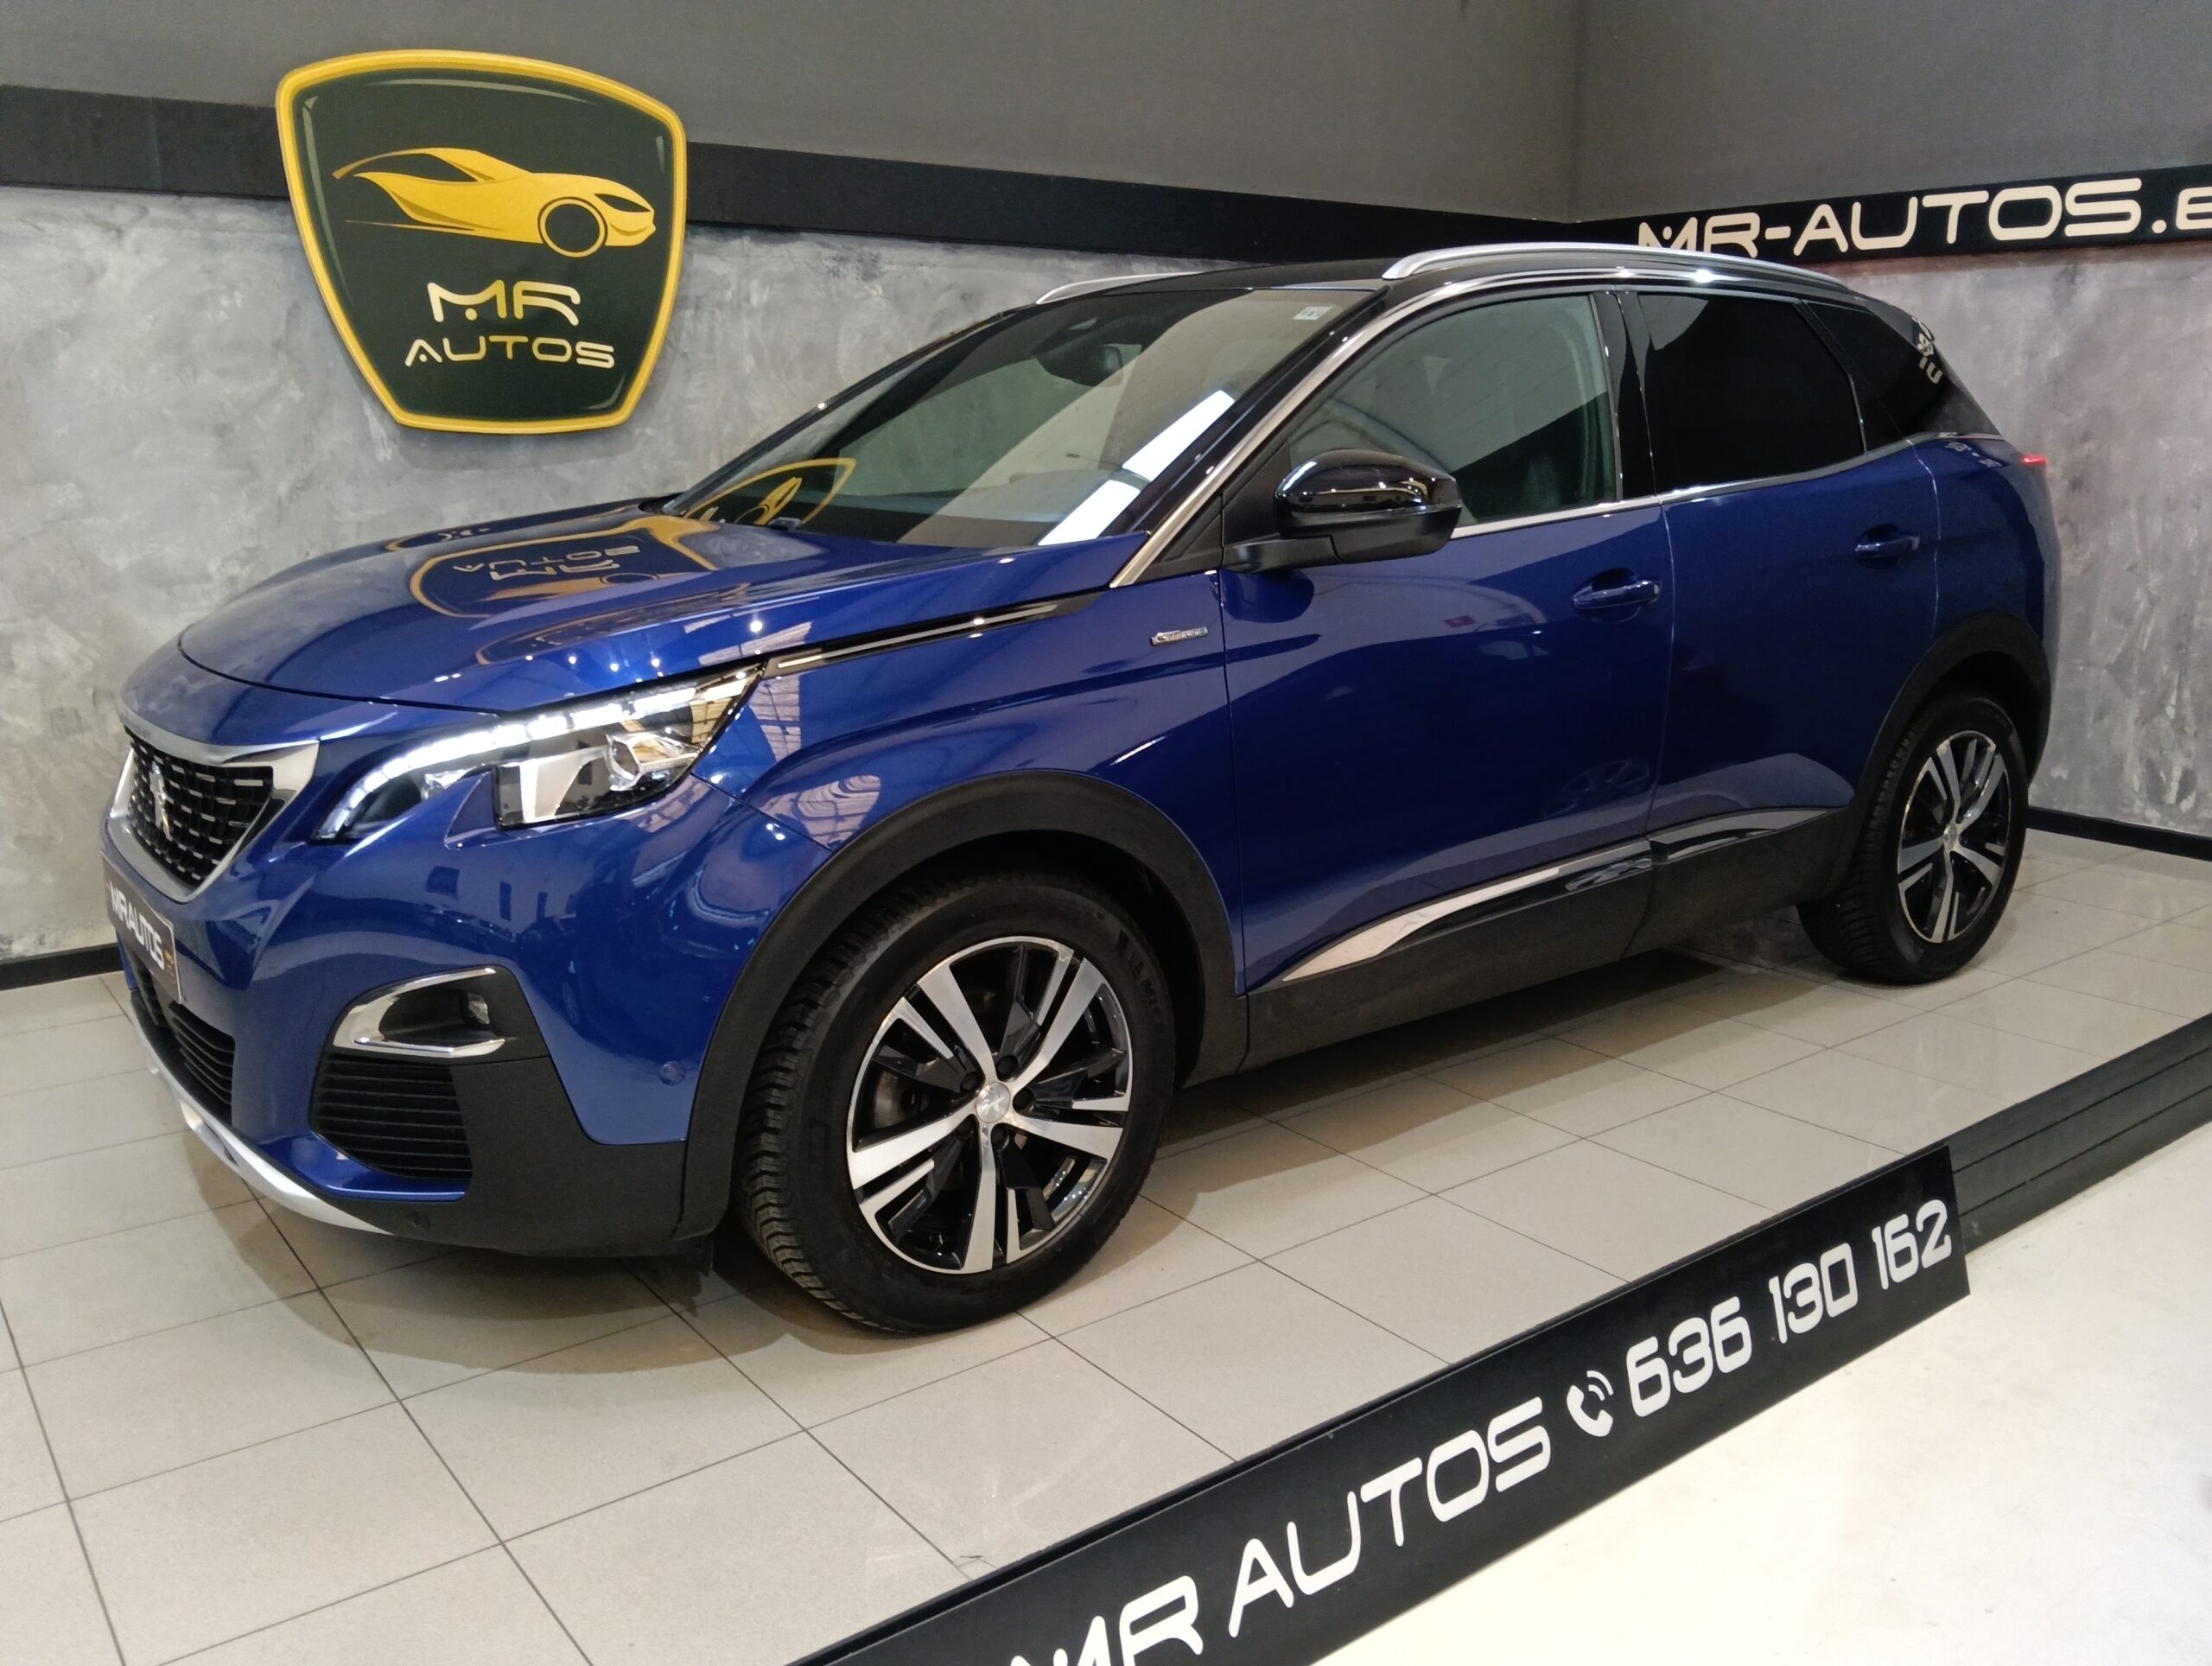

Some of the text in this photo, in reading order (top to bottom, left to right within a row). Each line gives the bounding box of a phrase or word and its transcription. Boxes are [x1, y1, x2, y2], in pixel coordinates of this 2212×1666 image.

[427, 279, 581, 326] MR
[405, 335, 615, 368] AUTOS
[1010, 1199, 1952, 1666] R AUTOS 636 130 162
